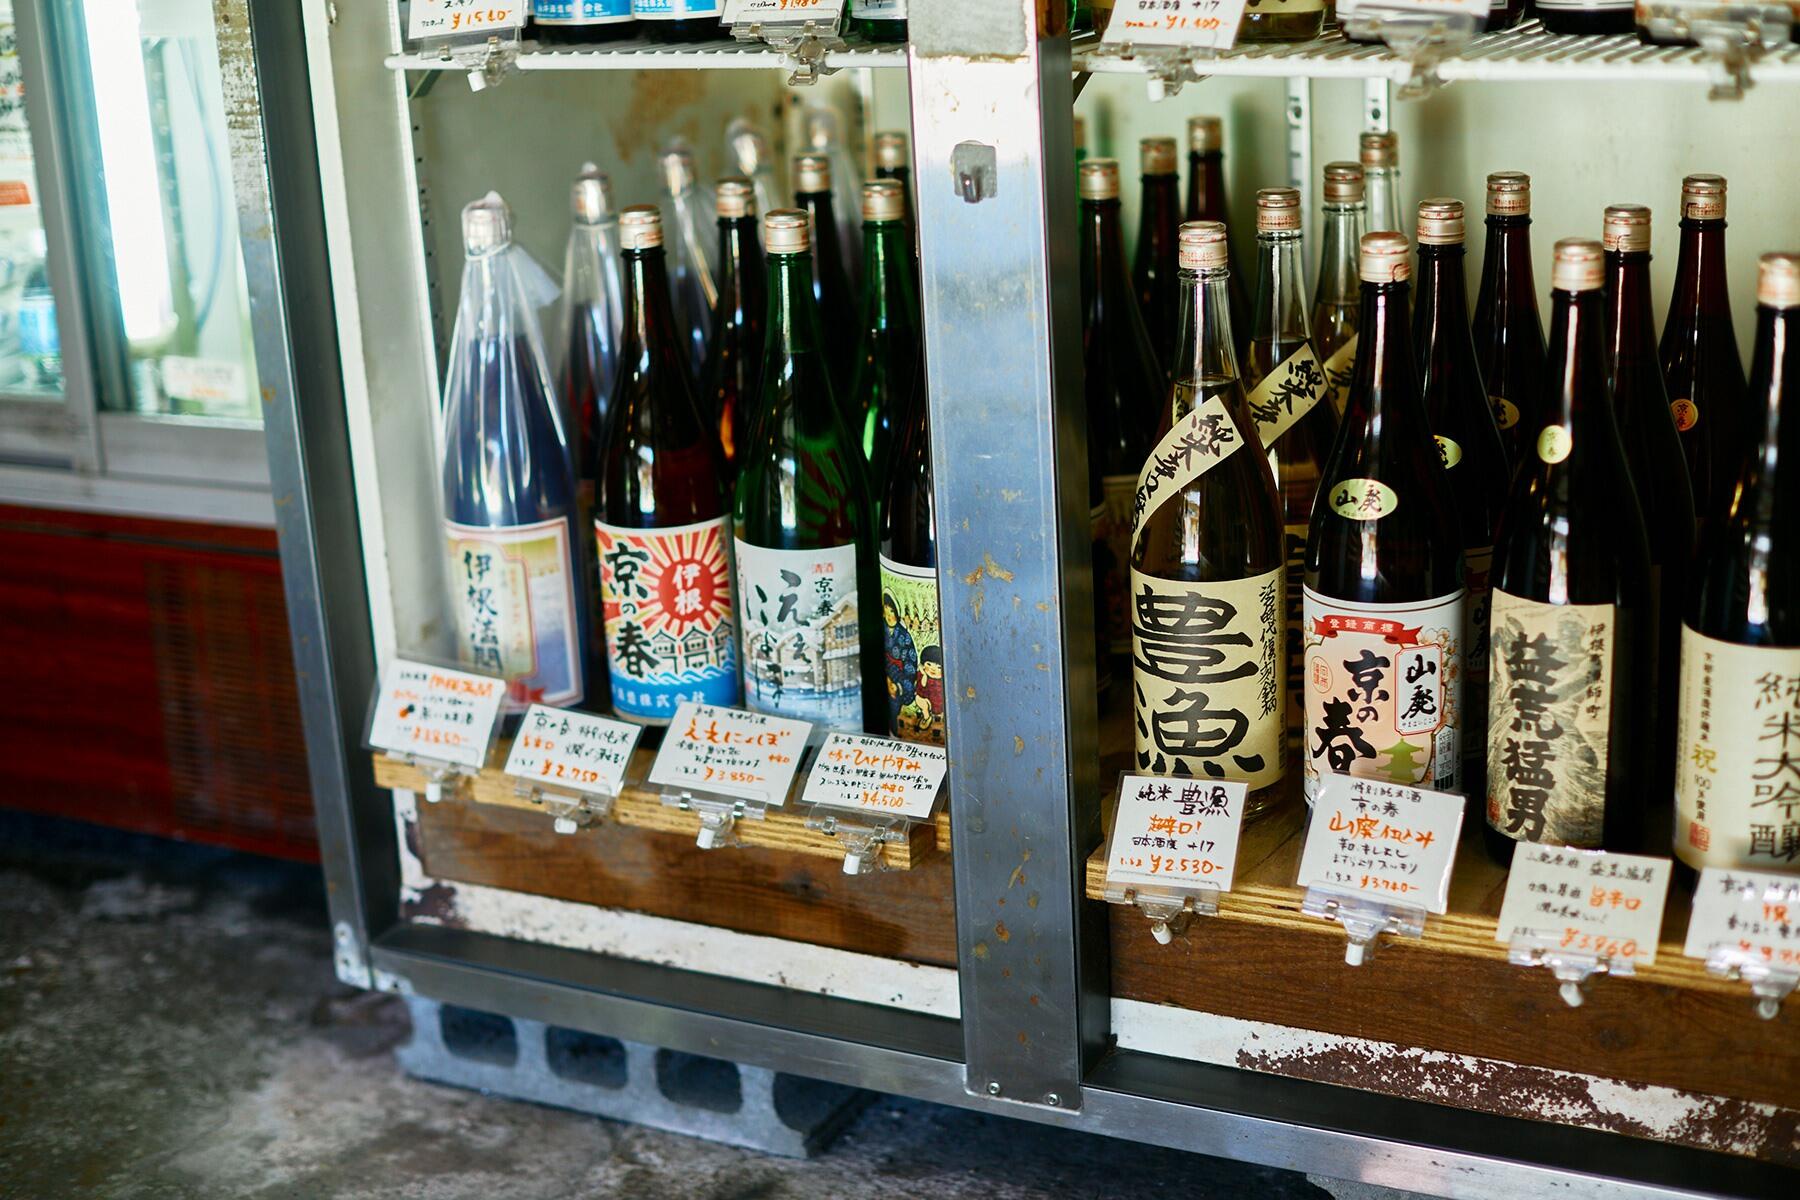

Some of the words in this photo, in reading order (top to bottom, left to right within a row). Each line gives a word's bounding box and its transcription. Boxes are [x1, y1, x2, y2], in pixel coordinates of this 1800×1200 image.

[605, 542, 661, 679] 京の春
[672, 563, 705, 616] 伊根
[814, 577, 836, 618] 京の春
[1311, 649, 1391, 772] 京の春
[1501, 631, 1569, 843] 益荒猛男
[1135, 783, 1173, 802] 純米
[1351, 796, 1401, 819] 京の春
[1131, 833, 1179, 851] 日本酒度
[1187, 840, 1216, 853] +17
